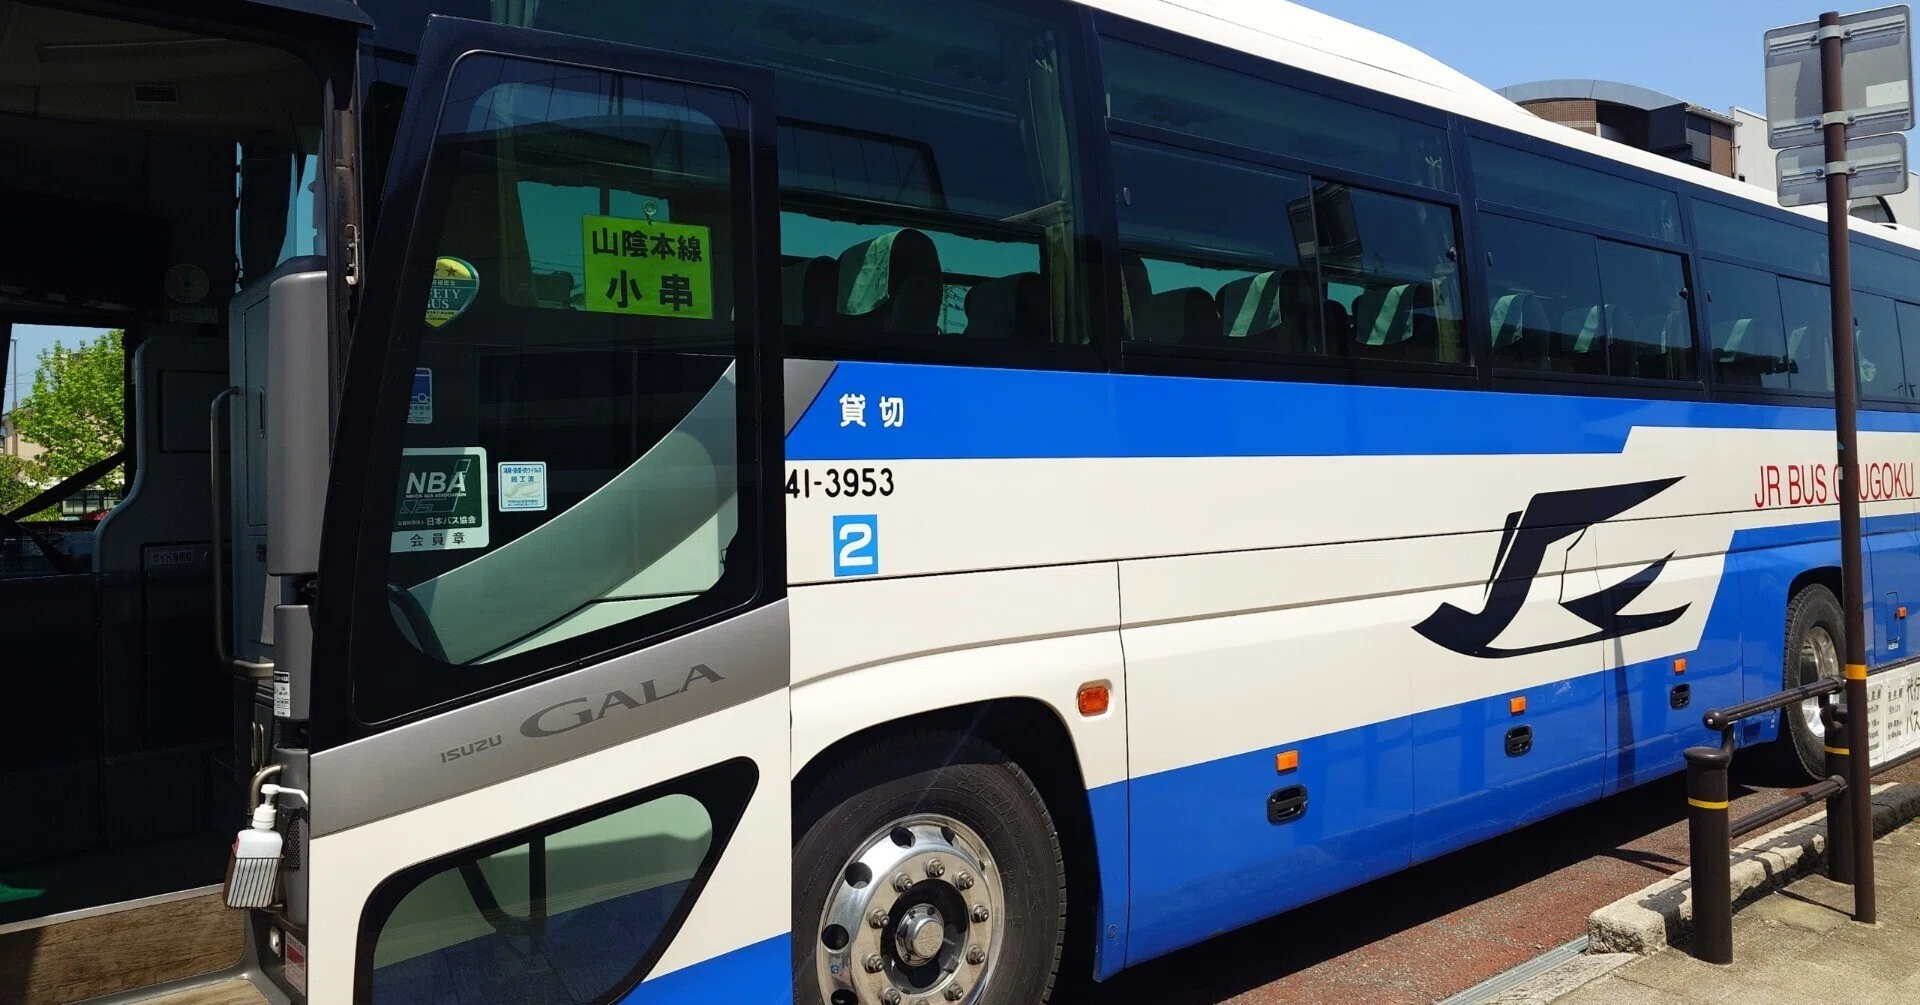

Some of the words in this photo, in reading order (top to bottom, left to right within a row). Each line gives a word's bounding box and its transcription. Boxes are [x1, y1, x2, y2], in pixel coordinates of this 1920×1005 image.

[592, 227, 702, 262] 山陰本線
[605, 269, 693, 311] 小串
[839, 393, 904, 428] 貸切
[405, 471, 466, 494] NBA
[785, 468, 894, 498] 41-3953
[1754, 465, 1782, 508] JR
[1788, 463, 1827, 505] BUS
[426, 515, 476, 526] 日本バス協会
[410, 532, 466, 547] 会員章
[839, 523, 873, 567] 2
[440, 734, 503, 764] ISUZU
[519, 663, 726, 738] GALA
